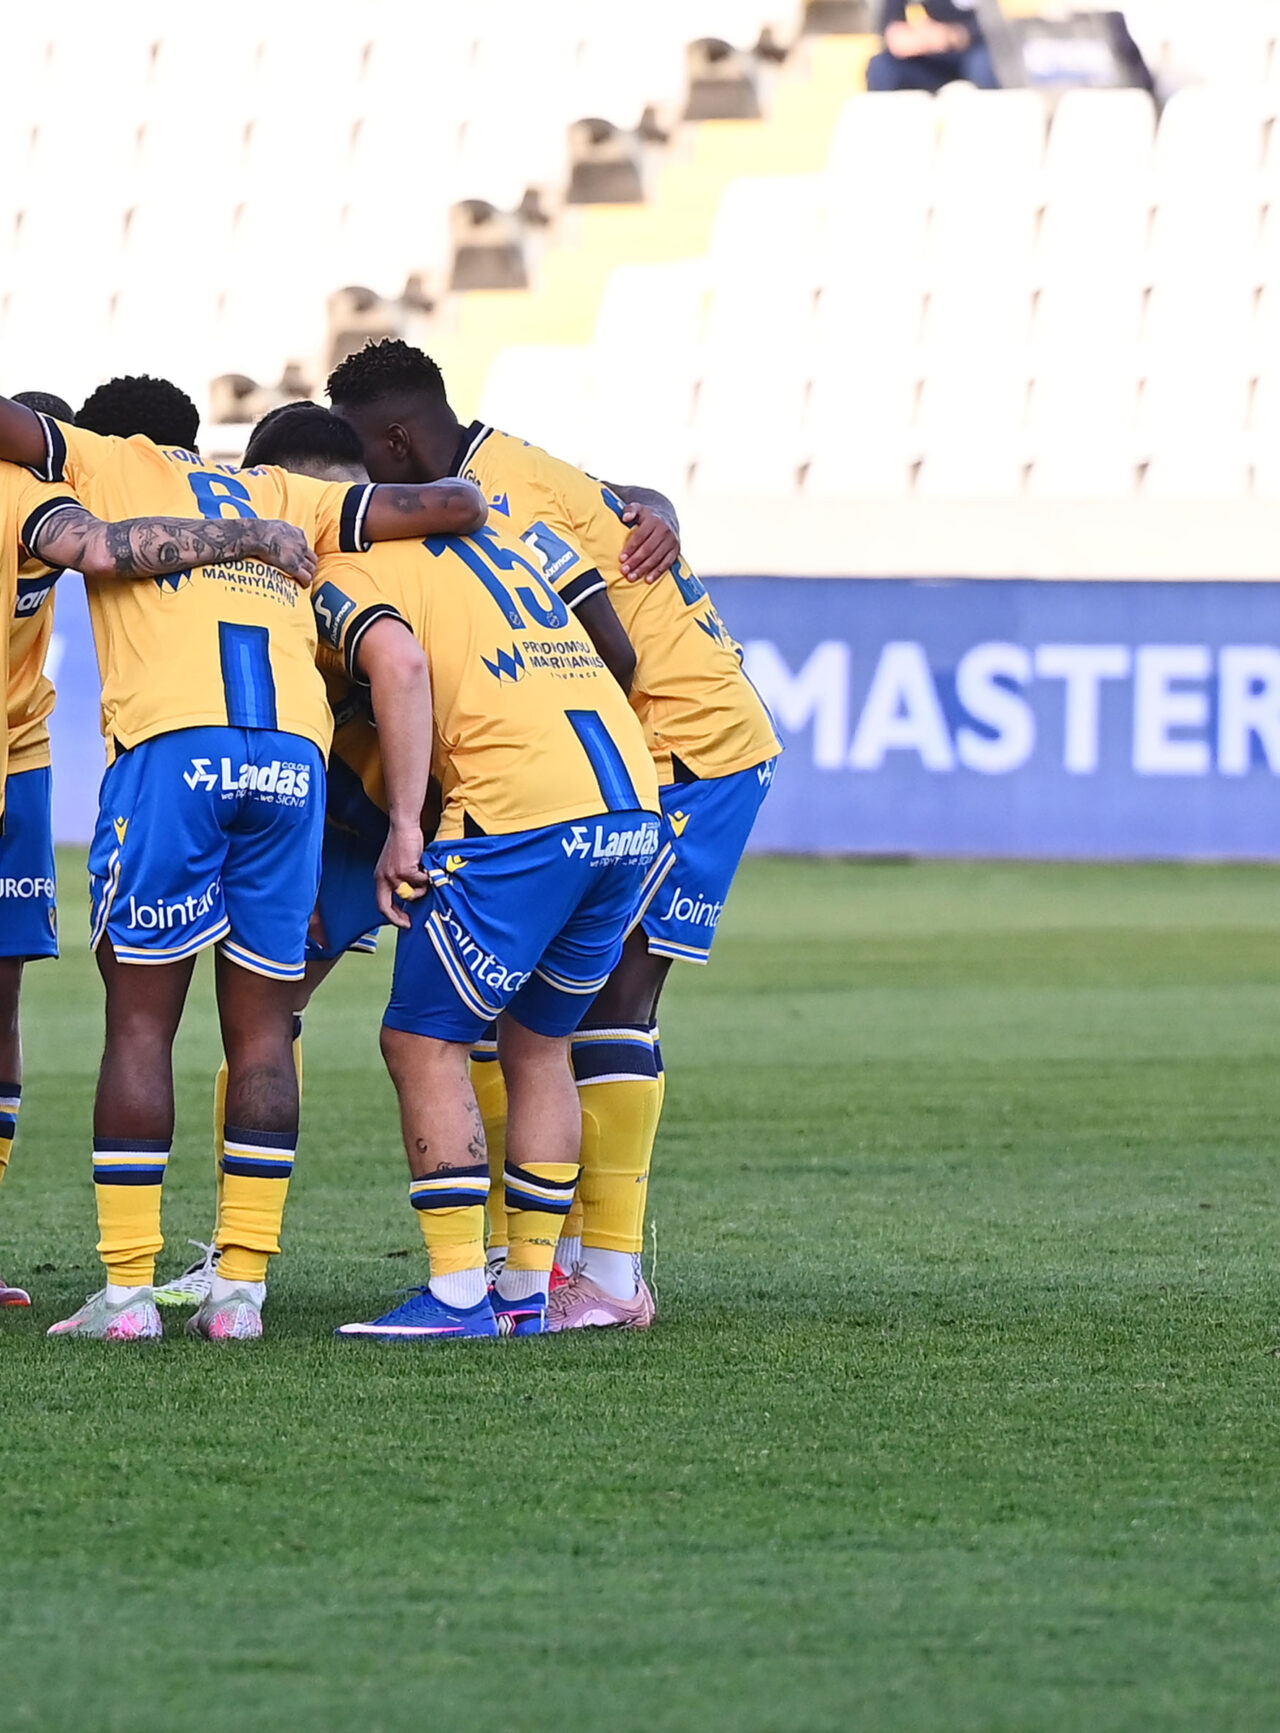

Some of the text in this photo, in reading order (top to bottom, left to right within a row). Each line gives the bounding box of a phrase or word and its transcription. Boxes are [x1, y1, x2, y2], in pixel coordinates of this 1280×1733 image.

[421, 525, 570, 630] 15
[17, 586, 51, 612] an
[221, 757, 311, 798] Landas
[592, 822, 659, 858] Landas
